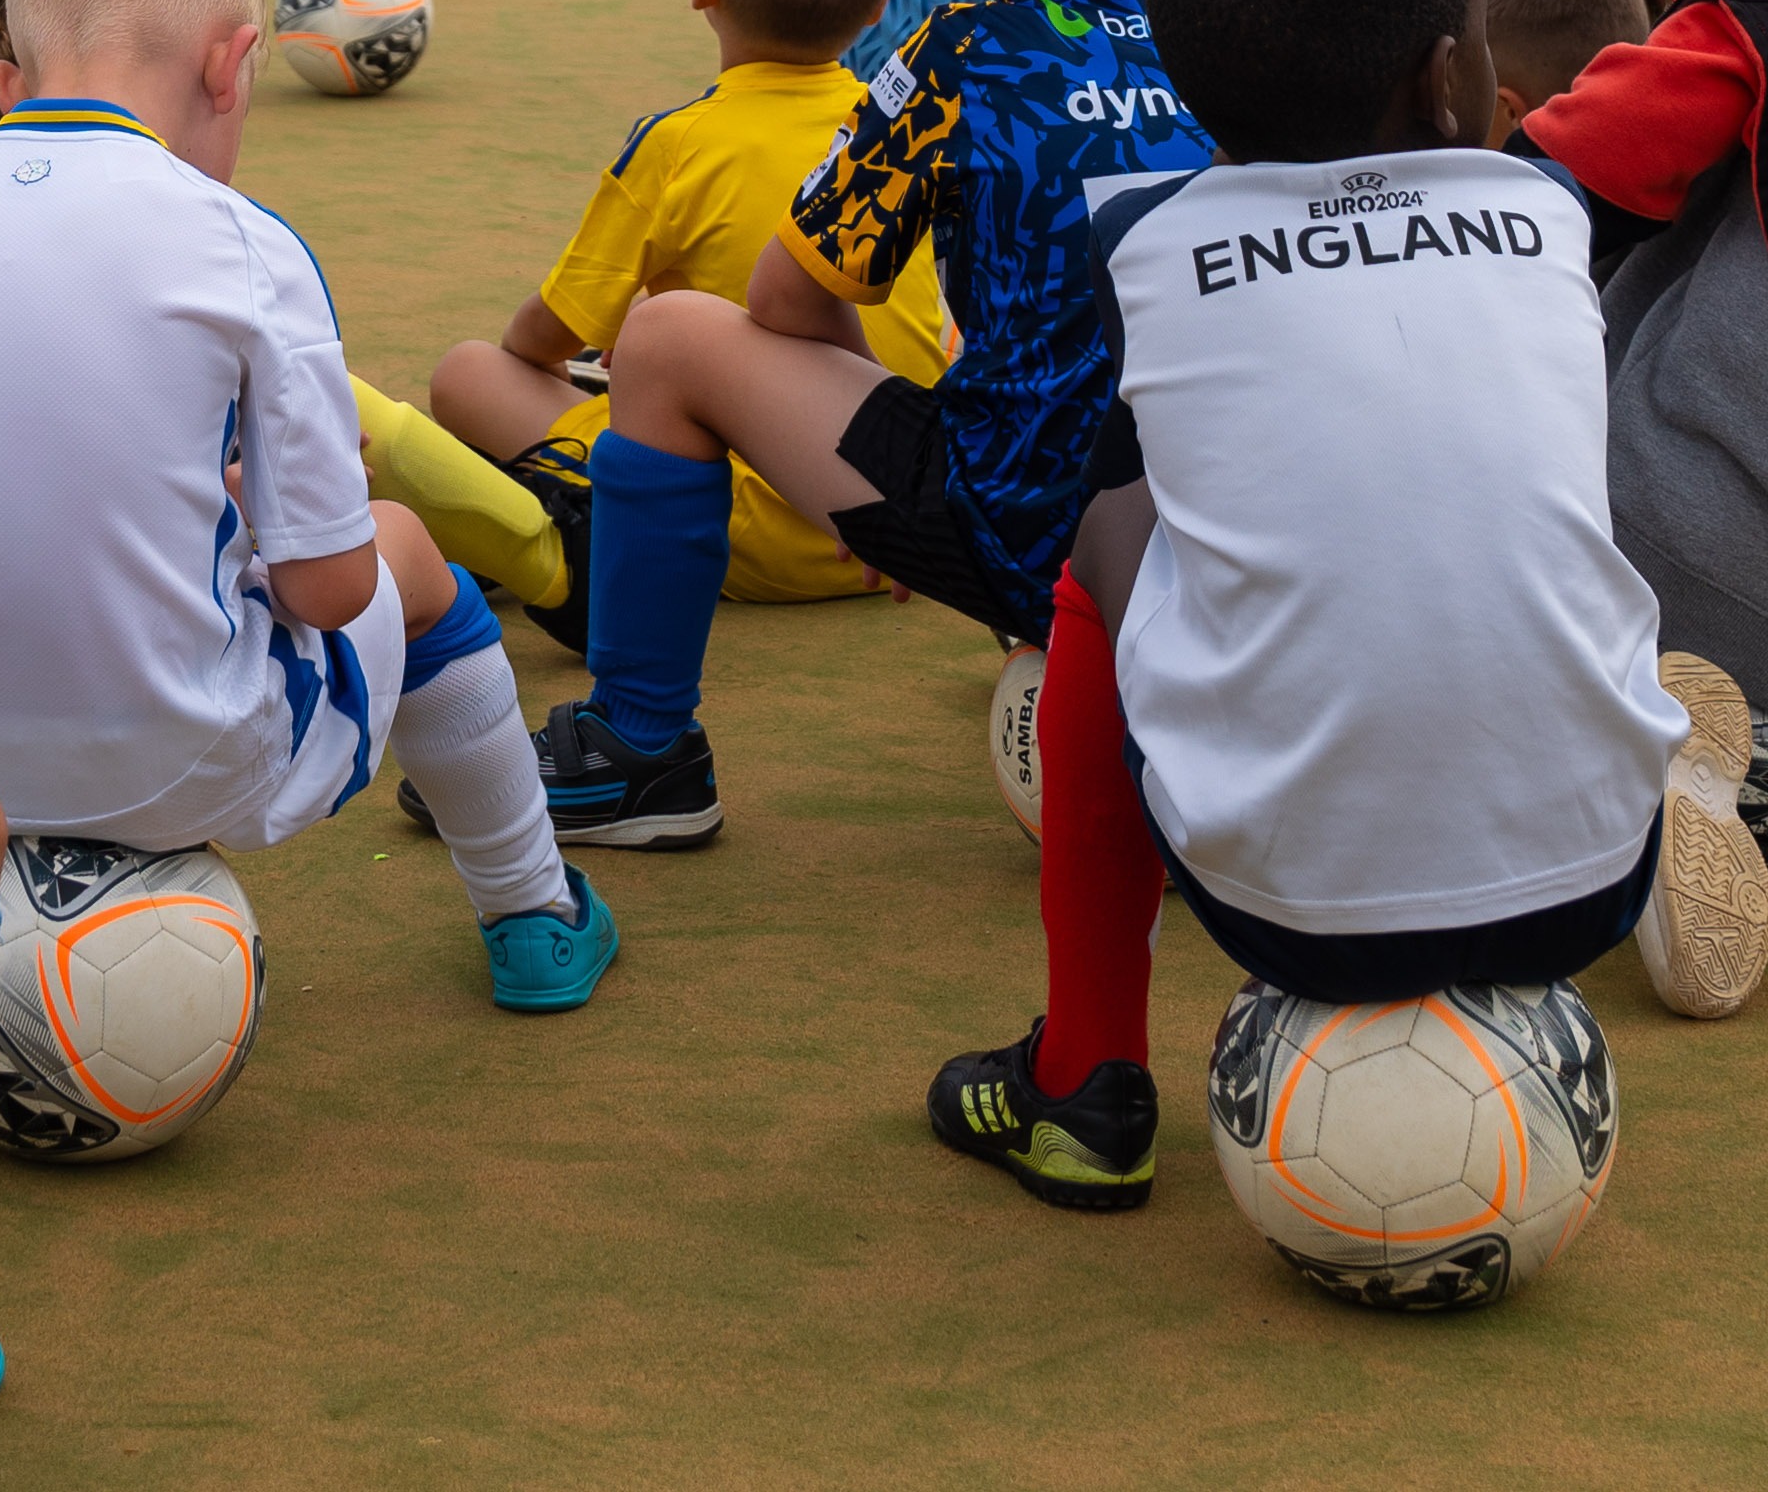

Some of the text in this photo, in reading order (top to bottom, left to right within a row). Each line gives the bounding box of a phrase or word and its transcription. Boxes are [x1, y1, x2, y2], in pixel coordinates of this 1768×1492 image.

[1097, 9, 1153, 39] ba
[1066, 79, 1192, 130] dyn
[1343, 175, 1384, 191] UEFA
[1192, 209, 1544, 296] ENGLAND
[1017, 685, 1039, 785] SAMBA
